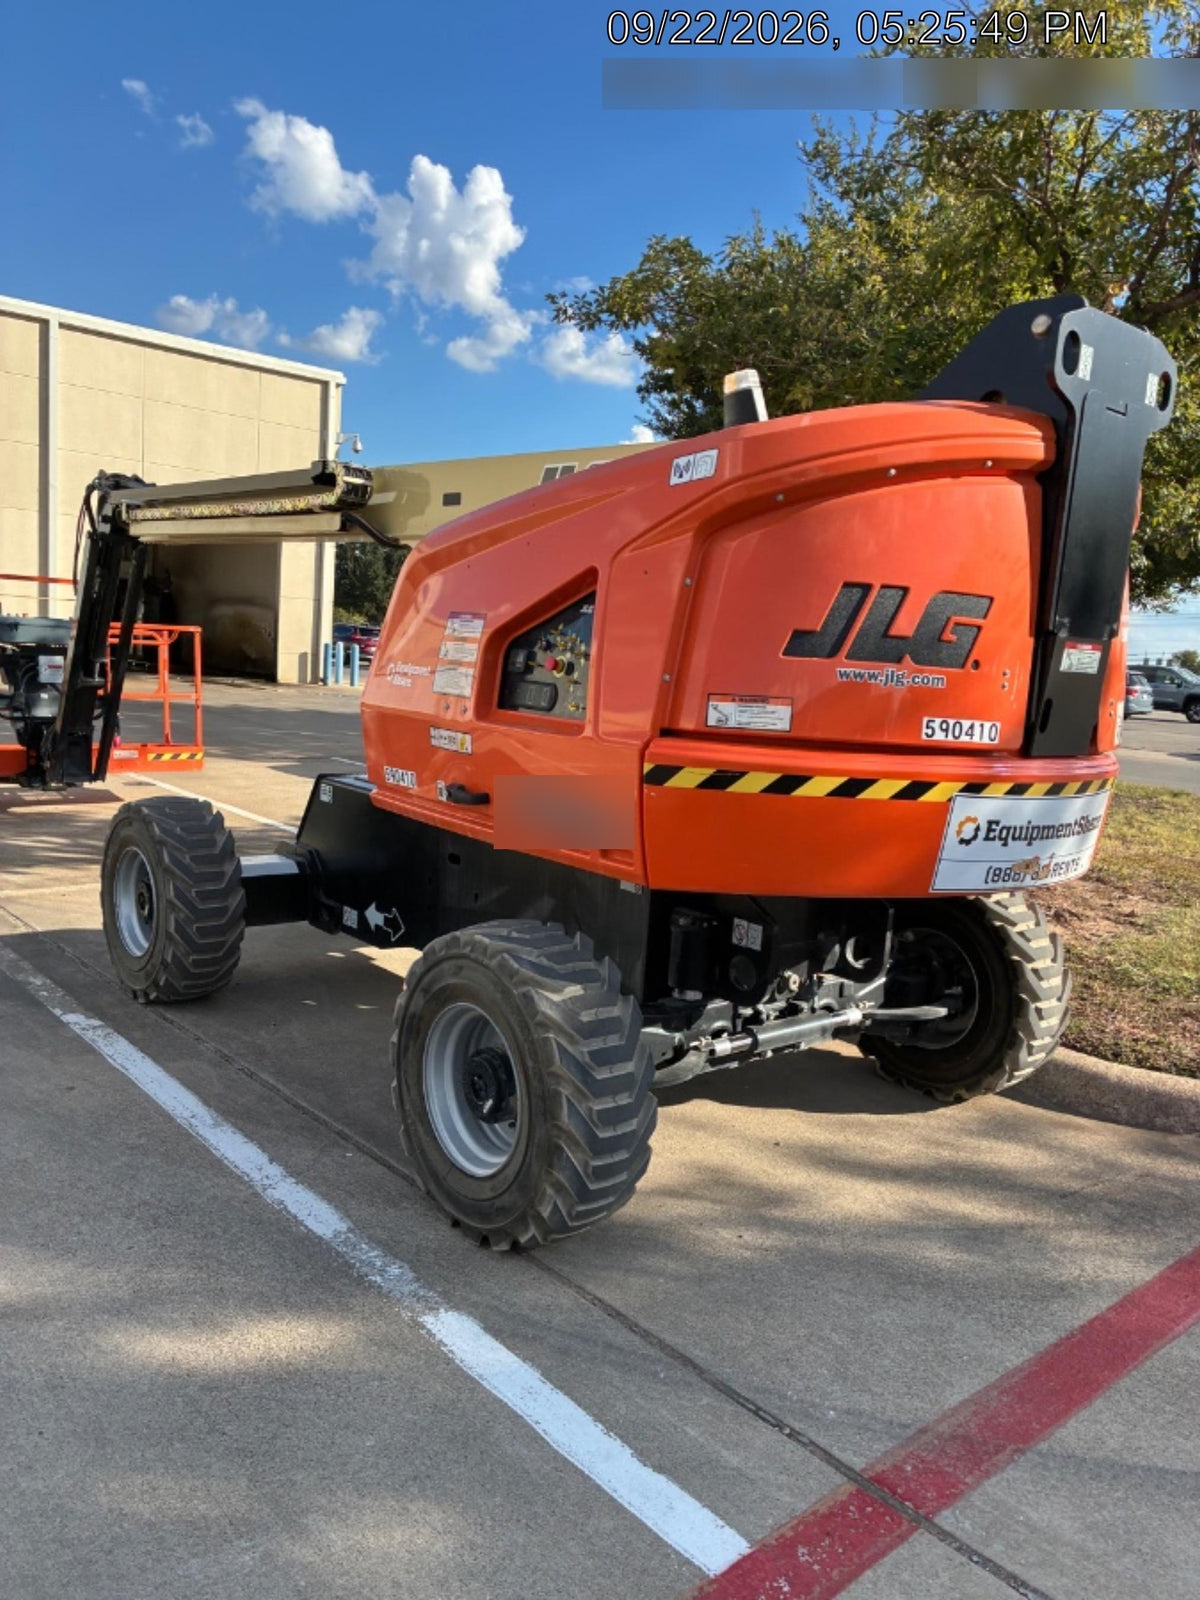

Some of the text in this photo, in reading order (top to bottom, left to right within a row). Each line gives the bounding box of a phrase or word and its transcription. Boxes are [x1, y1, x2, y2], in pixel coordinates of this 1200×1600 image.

[781, 582, 994, 669] JLG
[837, 667, 946, 688] www.jlg.com
[924, 718, 998, 743] 590410
